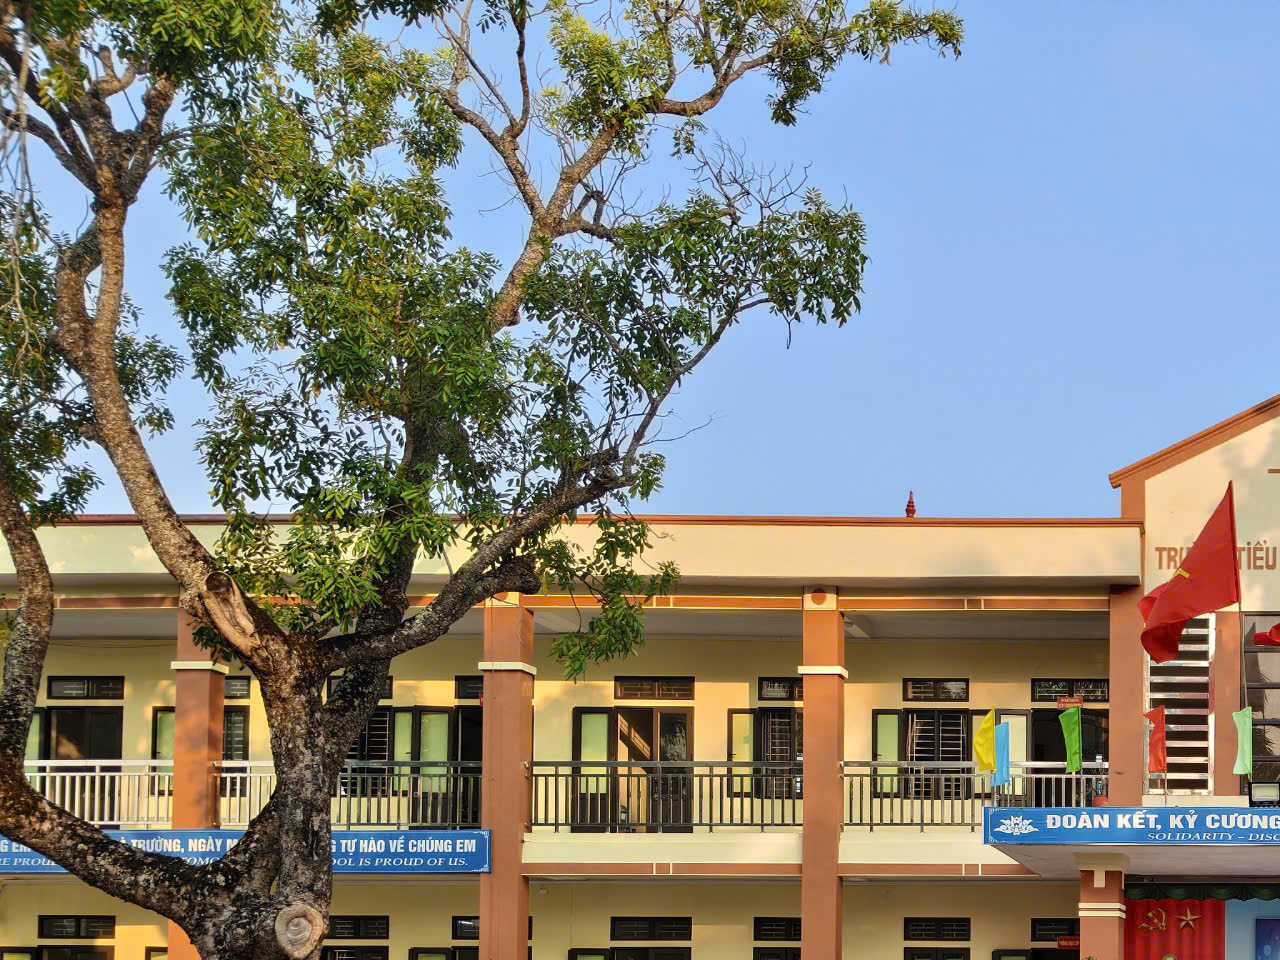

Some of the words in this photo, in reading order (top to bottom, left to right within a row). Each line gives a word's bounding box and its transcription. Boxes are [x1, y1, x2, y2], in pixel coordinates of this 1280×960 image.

[1046, 810, 1109, 829] ĐOÀN
[1117, 809, 1162, 832] KẾT,
[1169, 810, 1199, 829] KỶ
[130, 836, 185, 853] TRƯỜNG,
[188, 836, 224, 852] NGÀY
[1147, 832, 1236, 841] SOLIDARITY
[340, 838, 357, 856] TỰ
[360, 837, 385, 853] HÀO
[408, 837, 452, 853] CHÚNG
[456, 839, 476, 853] EM
[359, 858, 371, 866] IS
[375, 858, 424, 866] PROUD
[427, 858, 445, 866] OF
[448, 858, 468, 866] US.
